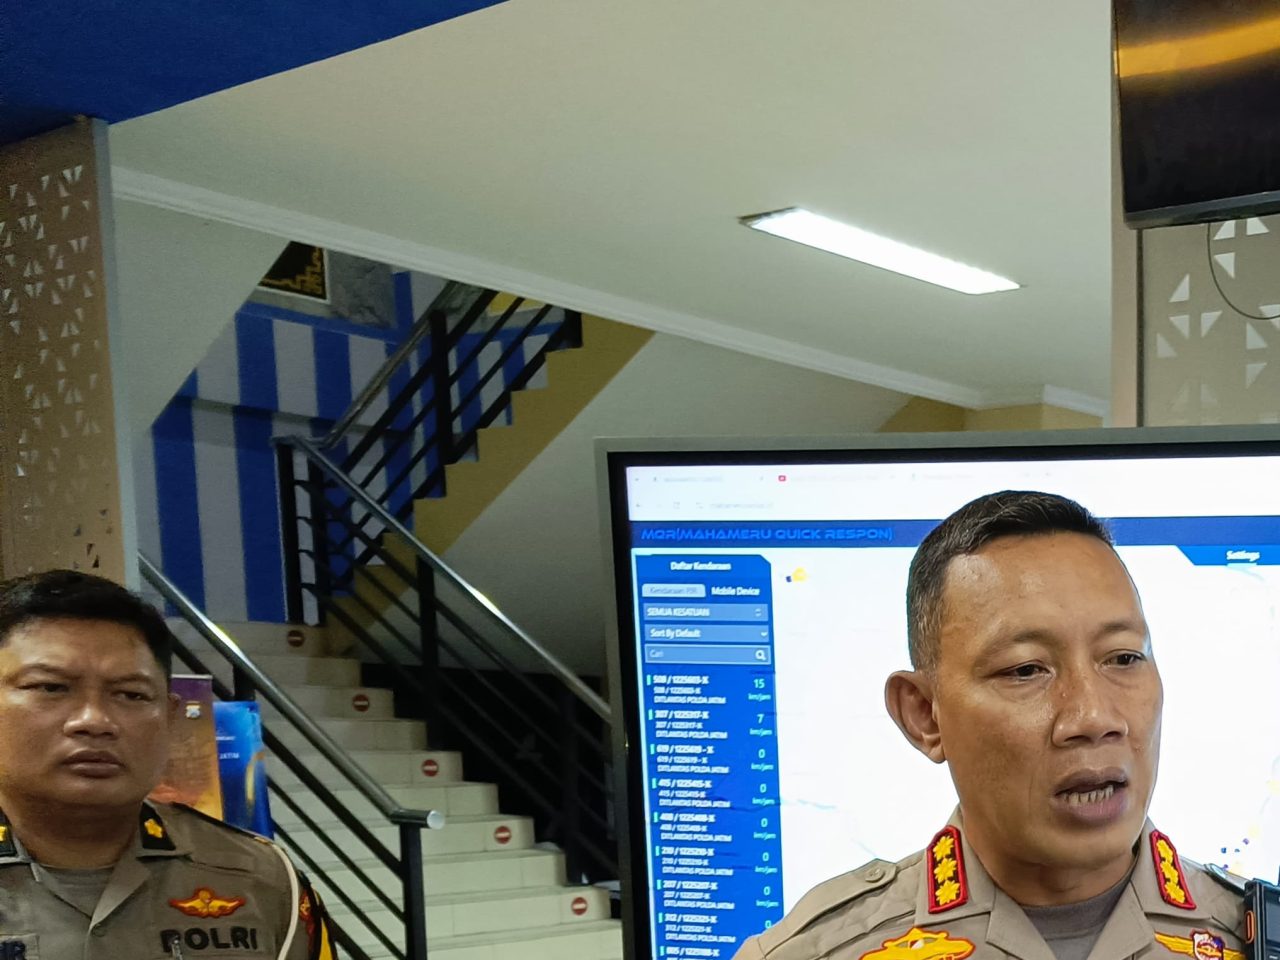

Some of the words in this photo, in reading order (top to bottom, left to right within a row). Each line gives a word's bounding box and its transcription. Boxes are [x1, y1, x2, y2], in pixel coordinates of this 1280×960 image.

[779, 528, 821, 540] QUICK
[711, 586, 735, 596] Mobile
[736, 586, 760, 596] Device
[647, 607, 672, 617] SEMUA
[673, 607, 710, 617] KESATUAN
[650, 629, 666, 638] Sort
[666, 629, 675, 639] By
[676, 629, 701, 638] Default
[754, 679, 764, 688] 15
[757, 714, 764, 723] 7
[758, 749, 765, 758] 0
[760, 784, 766, 793] 0
[761, 818, 767, 827] 0
[762, 852, 769, 861] 0
[764, 886, 770, 895] 0
[765, 920, 772, 930] 0
[160, 925, 257, 953] POLRI
